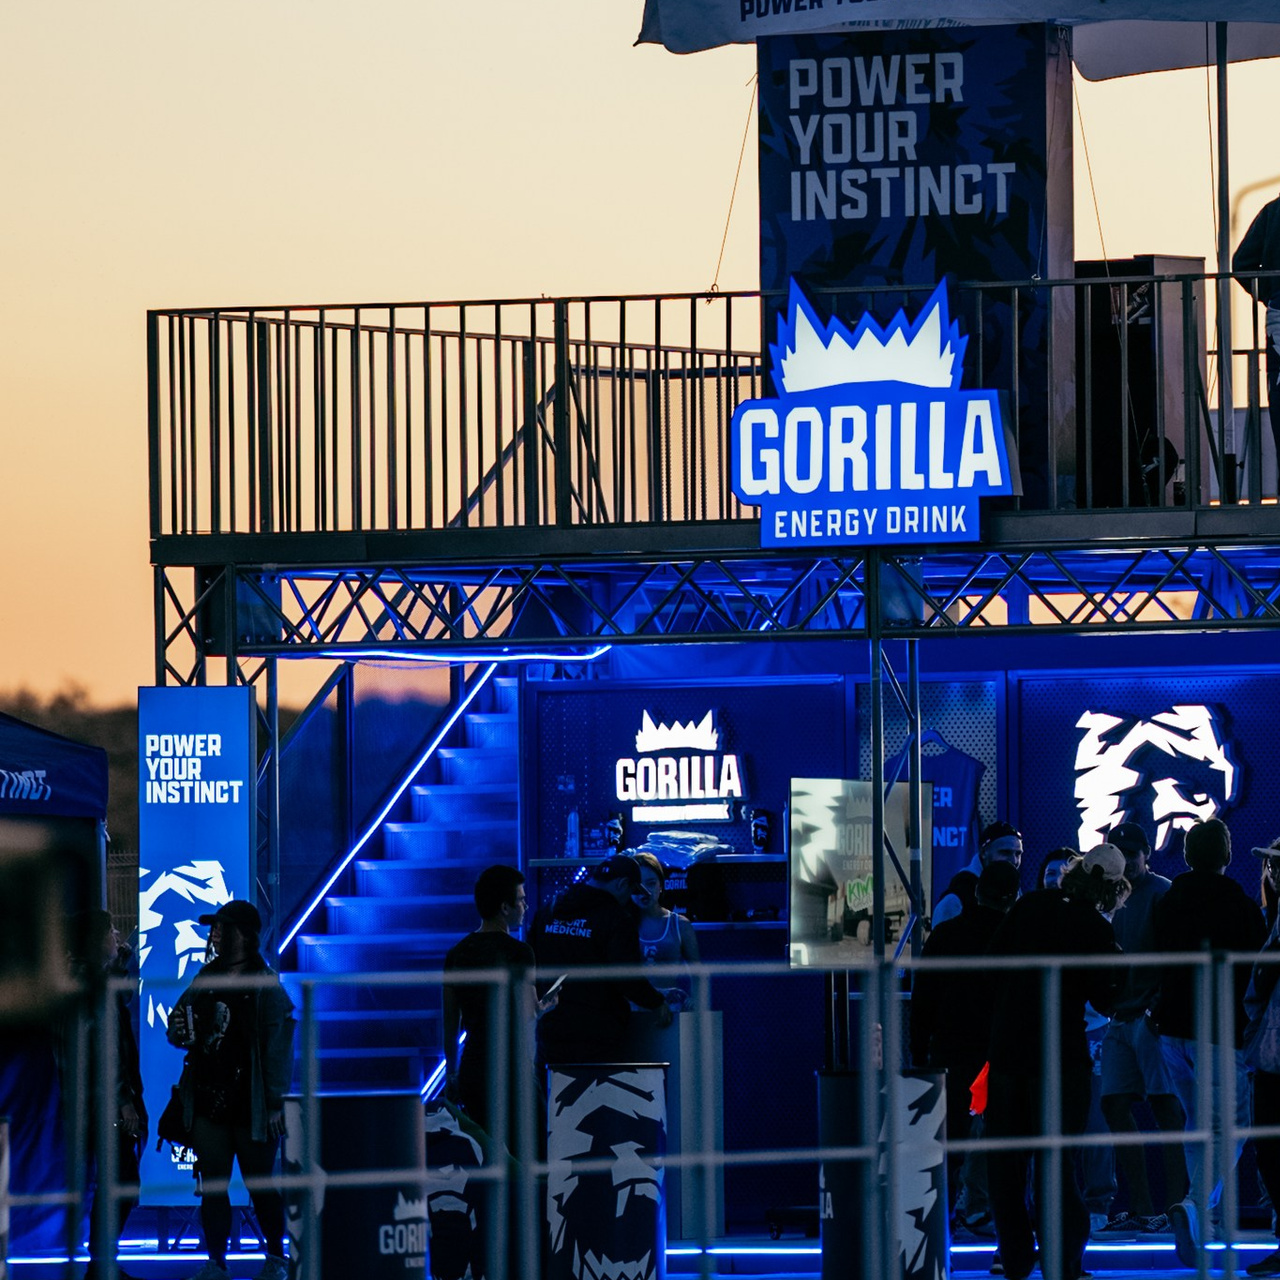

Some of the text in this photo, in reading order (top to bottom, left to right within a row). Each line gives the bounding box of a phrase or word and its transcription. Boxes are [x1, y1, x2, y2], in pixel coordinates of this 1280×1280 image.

[788, 52, 964, 110] POWER
[789, 110, 918, 165] YOUR
[790, 161, 1016, 222] INSTINCT
[739, 399, 1003, 496] GORILLA
[774, 504, 967, 538] ENERGY DRINK
[145, 734, 222, 757] POWER
[145, 758, 202, 780] YOUR
[615, 754, 743, 801] GORILLA
[145, 781, 243, 804] INSTINCT
[545, 924, 593, 938] MEDICINE
[553, 919, 588, 928] SORT
